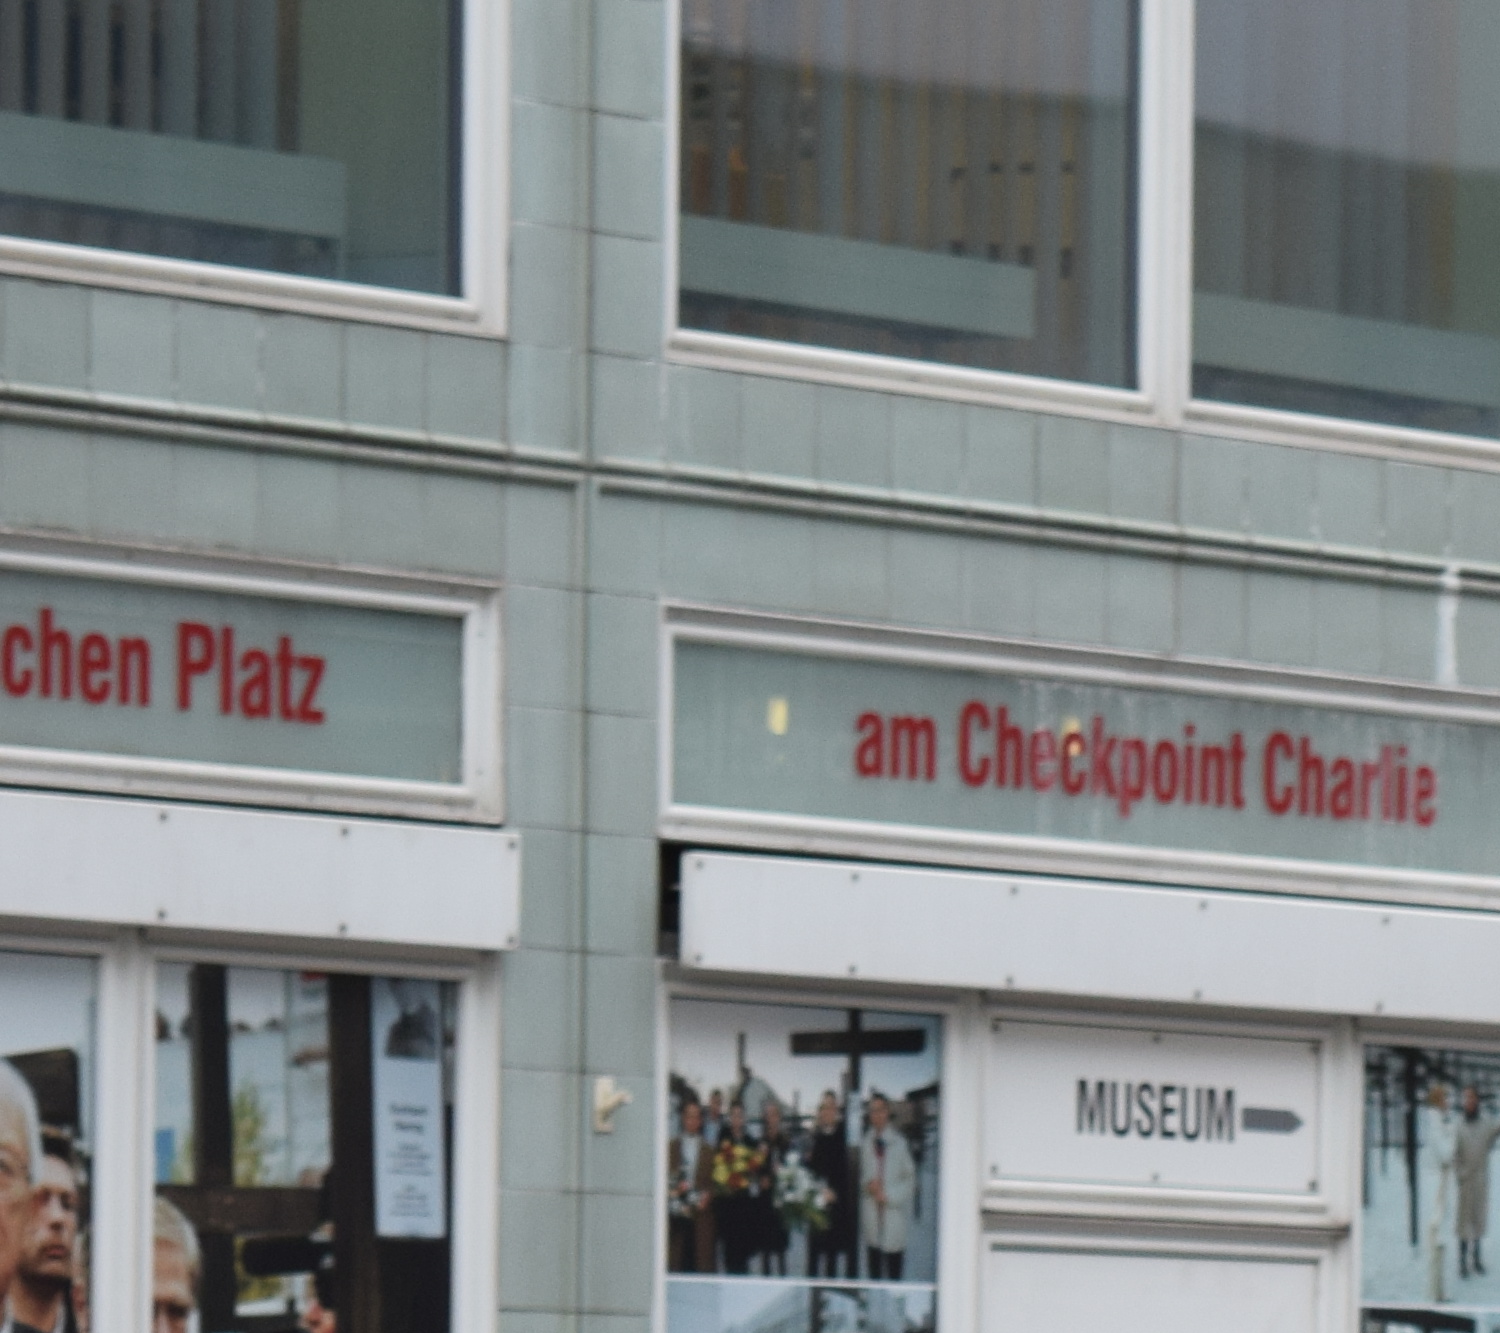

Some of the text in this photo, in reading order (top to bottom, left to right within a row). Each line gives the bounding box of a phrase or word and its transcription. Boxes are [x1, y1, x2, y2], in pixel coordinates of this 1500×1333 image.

[0, 608, 326, 724] chen Platz
[855, 701, 1437, 827] am Checkpoint Charlie
[1074, 1077, 1237, 1144] MUSEUM
